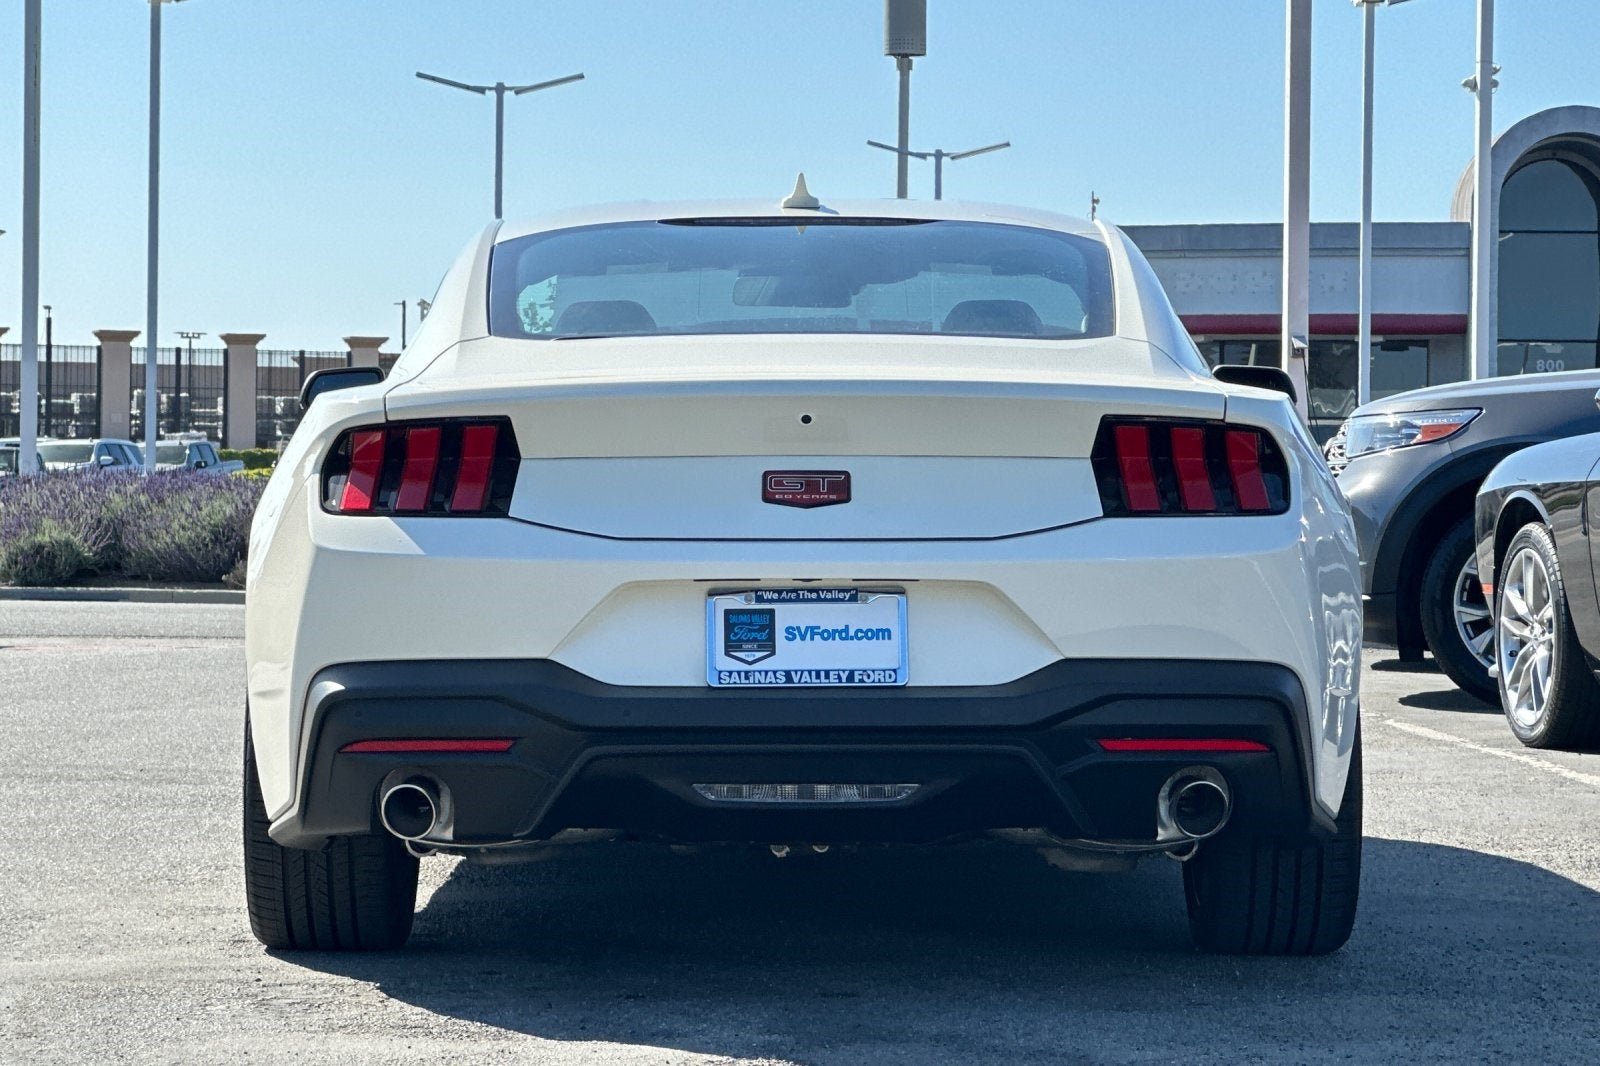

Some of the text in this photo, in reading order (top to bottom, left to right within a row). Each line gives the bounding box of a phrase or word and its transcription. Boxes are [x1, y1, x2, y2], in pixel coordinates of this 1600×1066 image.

[1536, 359, 1565, 372] 800
[768, 475, 845, 492] GT
[780, 591, 797, 600] Are
[798, 591, 817, 599] The
[730, 625, 769, 640] Ford
[784, 625, 892, 642] SVFord.com
[719, 670, 897, 684] SALINAS VALLEY FORD
